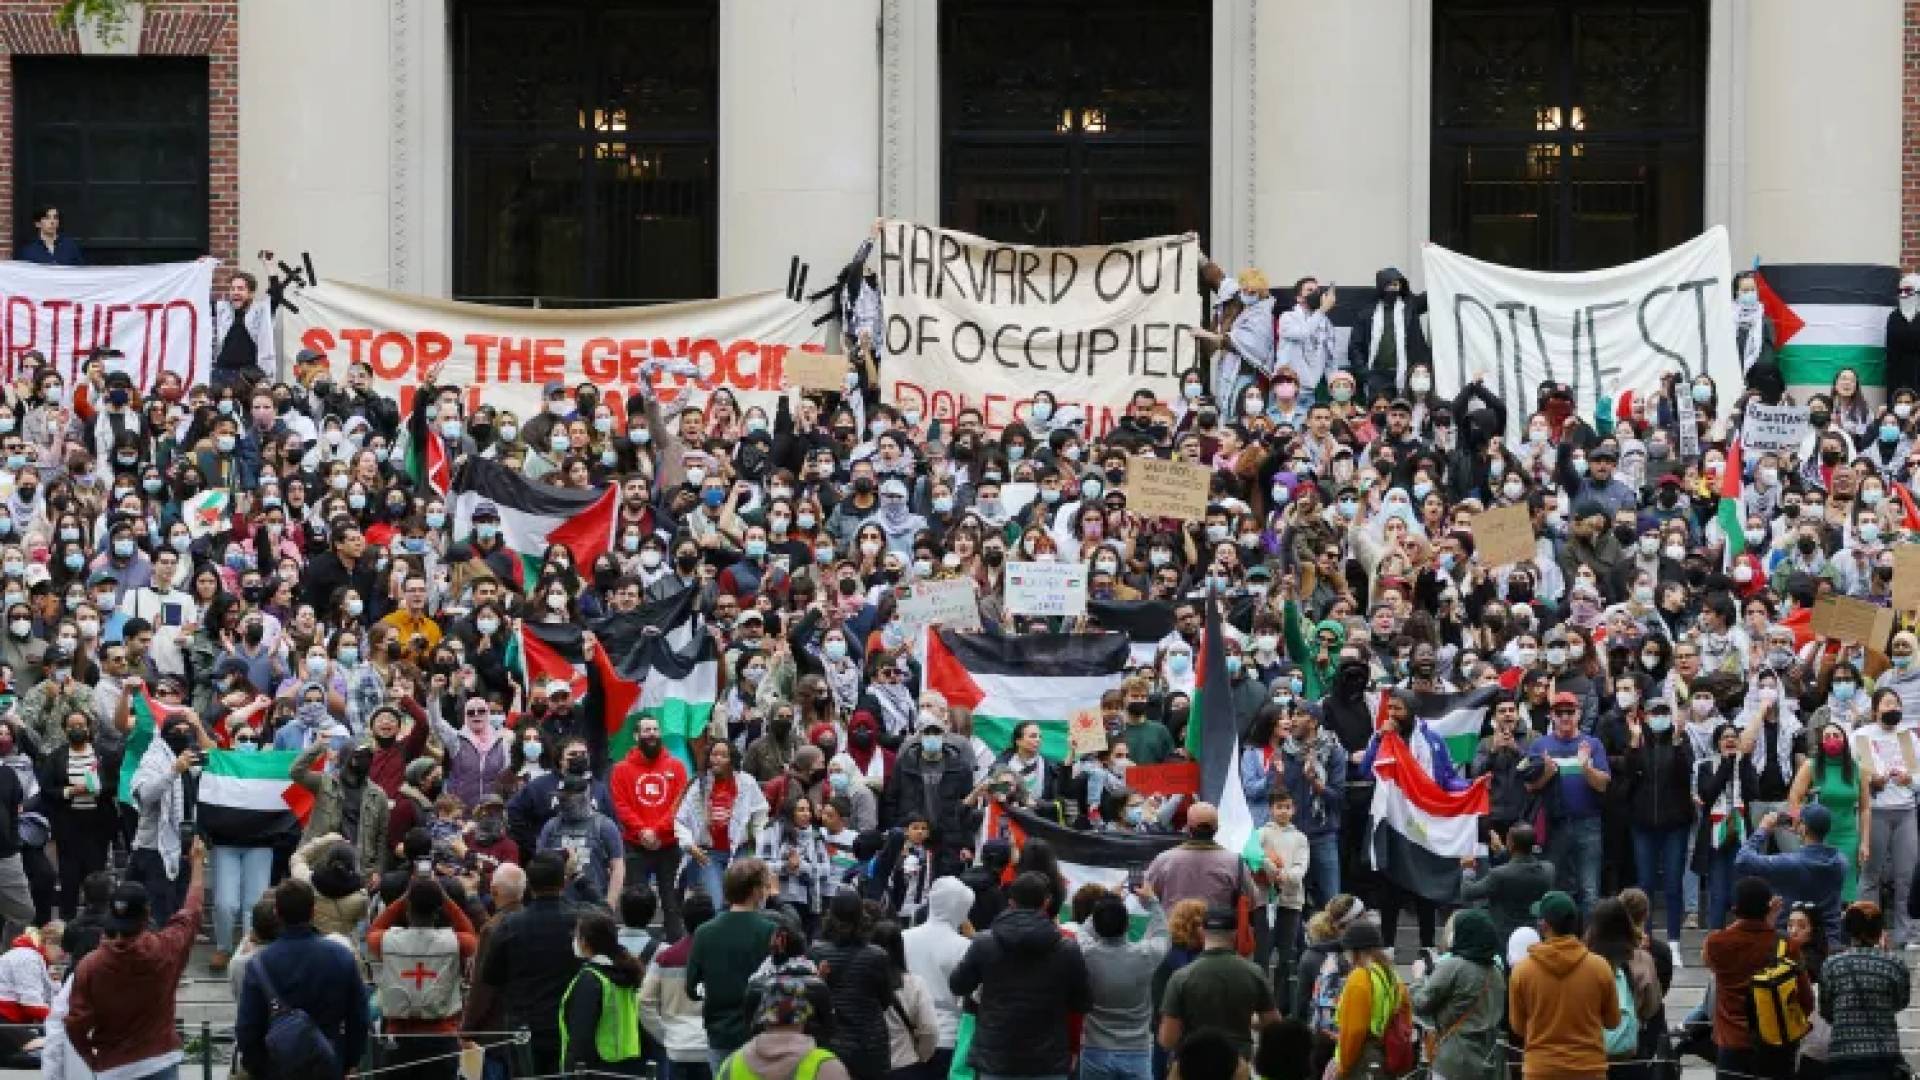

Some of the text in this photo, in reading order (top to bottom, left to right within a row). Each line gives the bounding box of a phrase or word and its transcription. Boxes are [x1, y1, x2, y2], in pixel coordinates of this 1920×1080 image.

[880, 223, 1196, 304] HARVARD OUT
[0, 296, 197, 396] RTHEID
[293, 328, 827, 392] STOP THE GENOCI
[886, 313, 1201, 378] OF OCCUPIED
[1455, 278, 1719, 430] DIVEST
